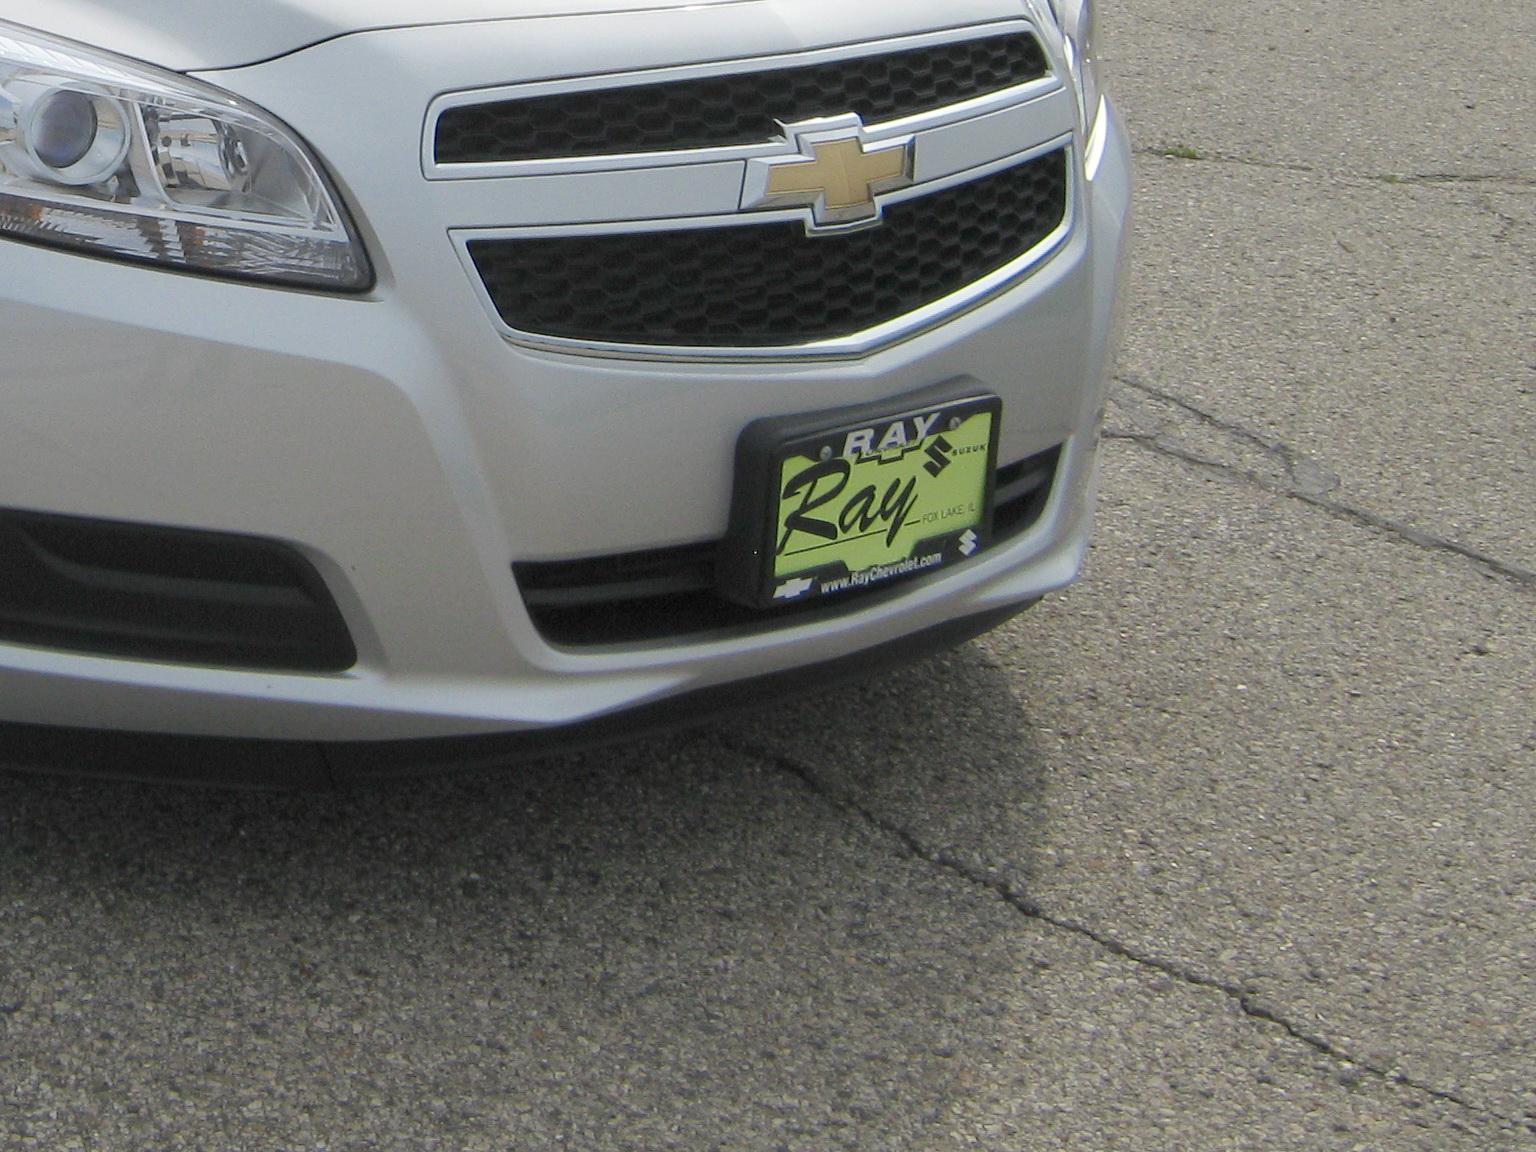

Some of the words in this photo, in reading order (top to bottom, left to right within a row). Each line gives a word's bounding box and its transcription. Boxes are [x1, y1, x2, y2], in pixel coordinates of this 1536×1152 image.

[841, 412, 941, 458] RAY
[951, 444, 987, 456] SUZUK
[776, 458, 918, 555] Ray
[820, 552, 942, 594] www.RayChevrolet.com
